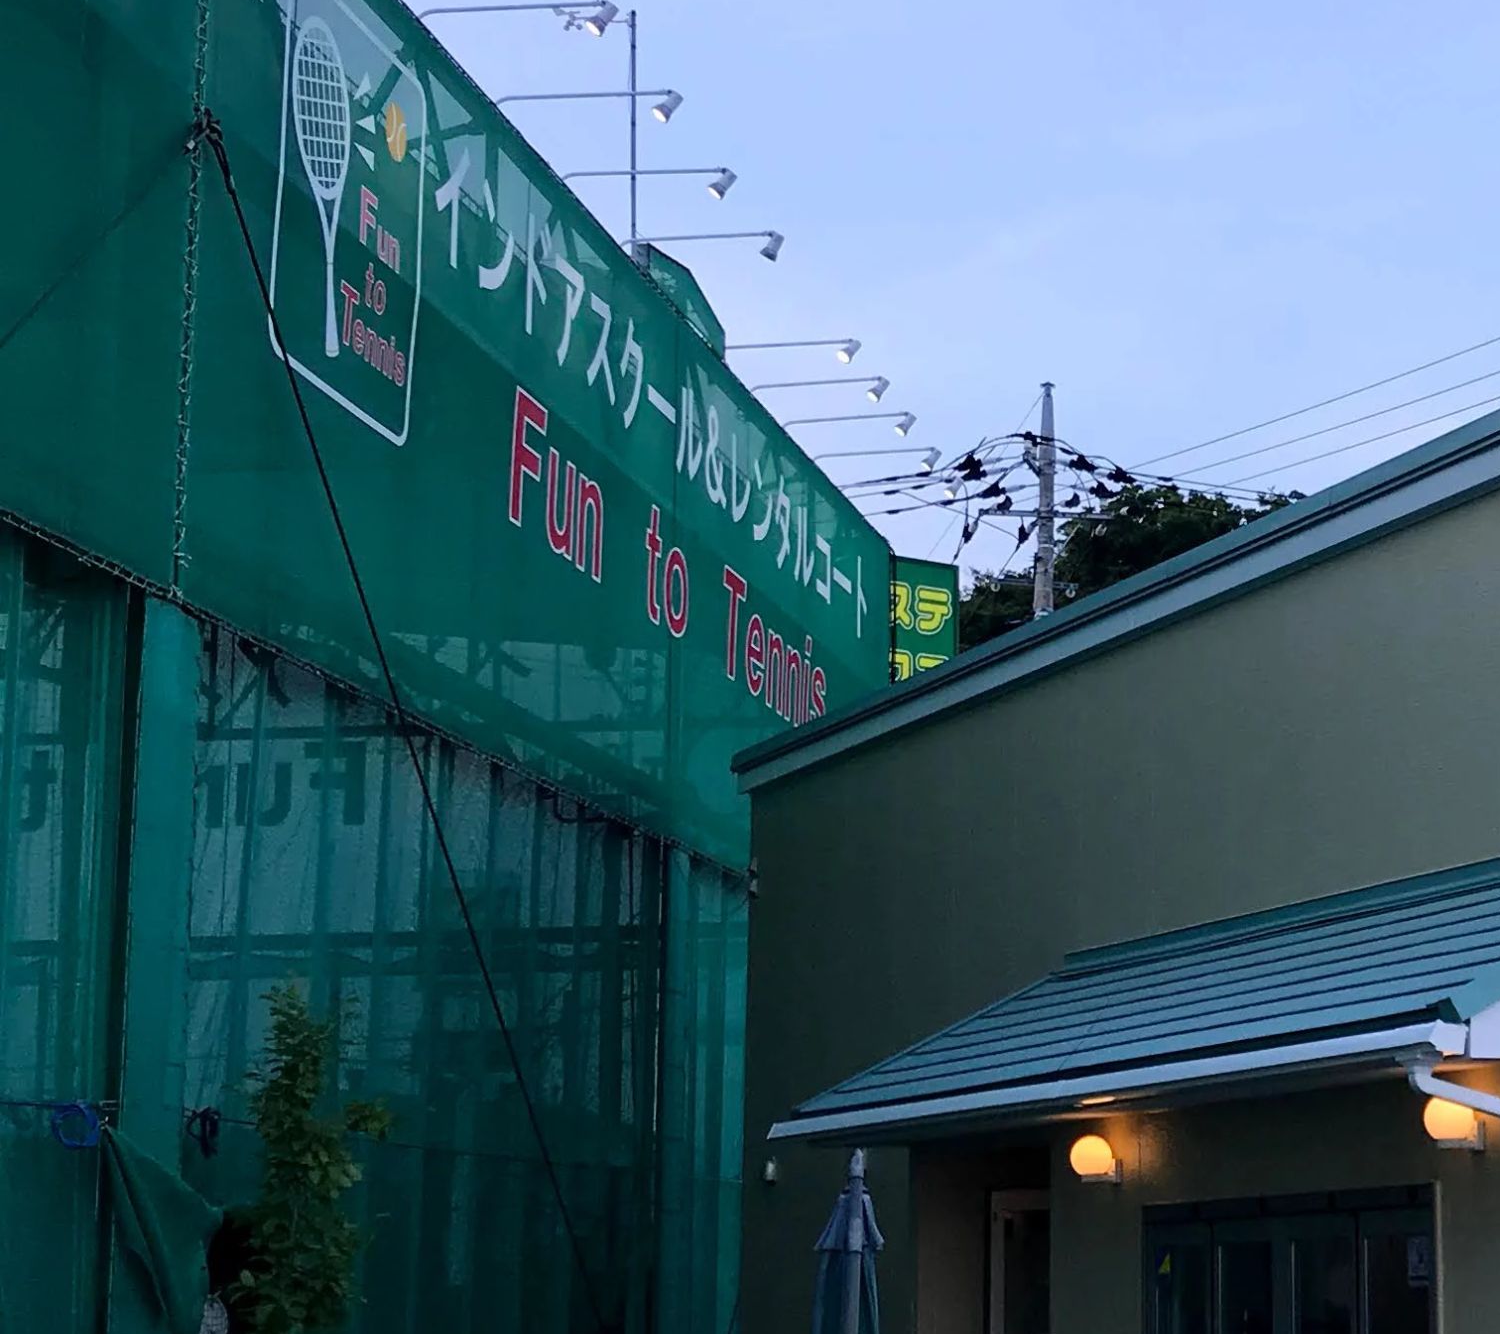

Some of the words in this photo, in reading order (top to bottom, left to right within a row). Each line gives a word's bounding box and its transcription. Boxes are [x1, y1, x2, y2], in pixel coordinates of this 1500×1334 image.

[358, 184, 401, 275] Fun
[340, 278, 407, 387] Tennis
[364, 262, 387, 316] to
[434, 146, 868, 639] インドアスクール&レンタルコート
[508, 384, 604, 584] Fun
[645, 504, 689, 638] to
[723, 563, 827, 728] Tennis
